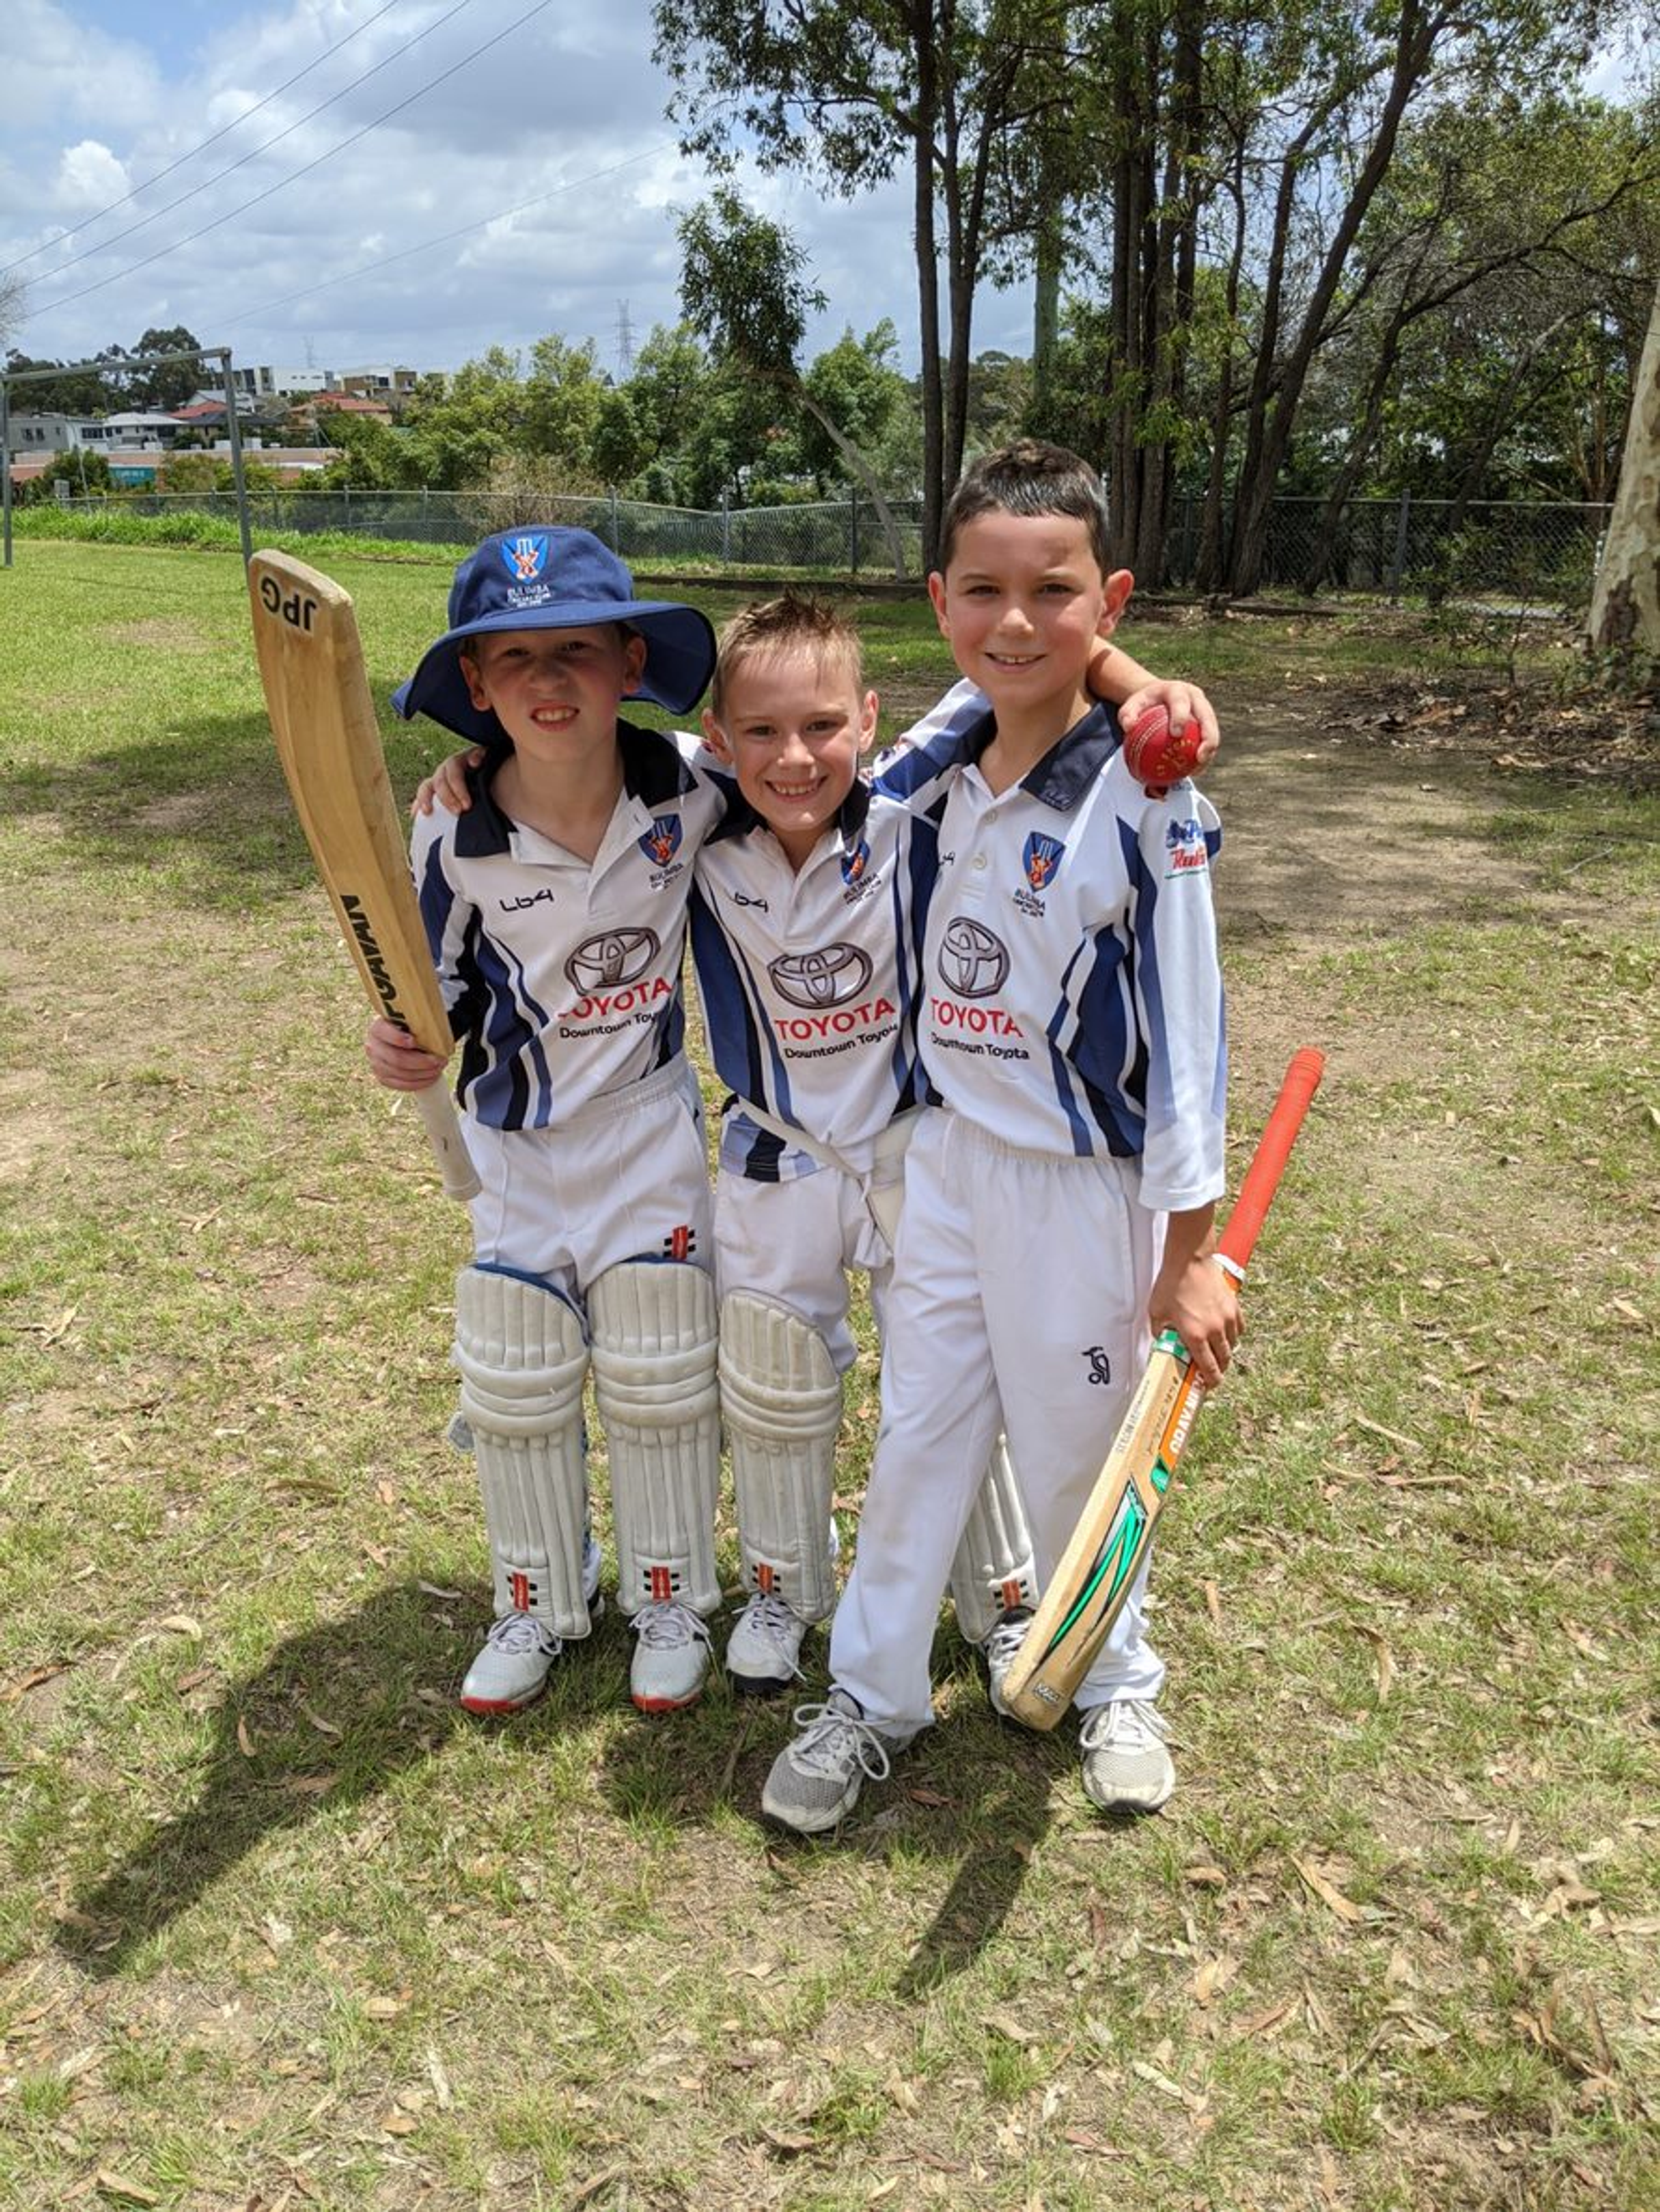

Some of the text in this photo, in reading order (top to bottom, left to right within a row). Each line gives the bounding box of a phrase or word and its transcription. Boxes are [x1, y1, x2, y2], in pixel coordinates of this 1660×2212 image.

[261, 577, 317, 631] JPG
[558, 977, 673, 1019] OYOTA
[931, 998, 1024, 1037] TOYOTA
[559, 1020, 631, 1038] Downtown
[775, 998, 896, 1040] TOYOTA
[783, 1040, 857, 1059] Downtown
[984, 1043, 1030, 1060] Toyota
